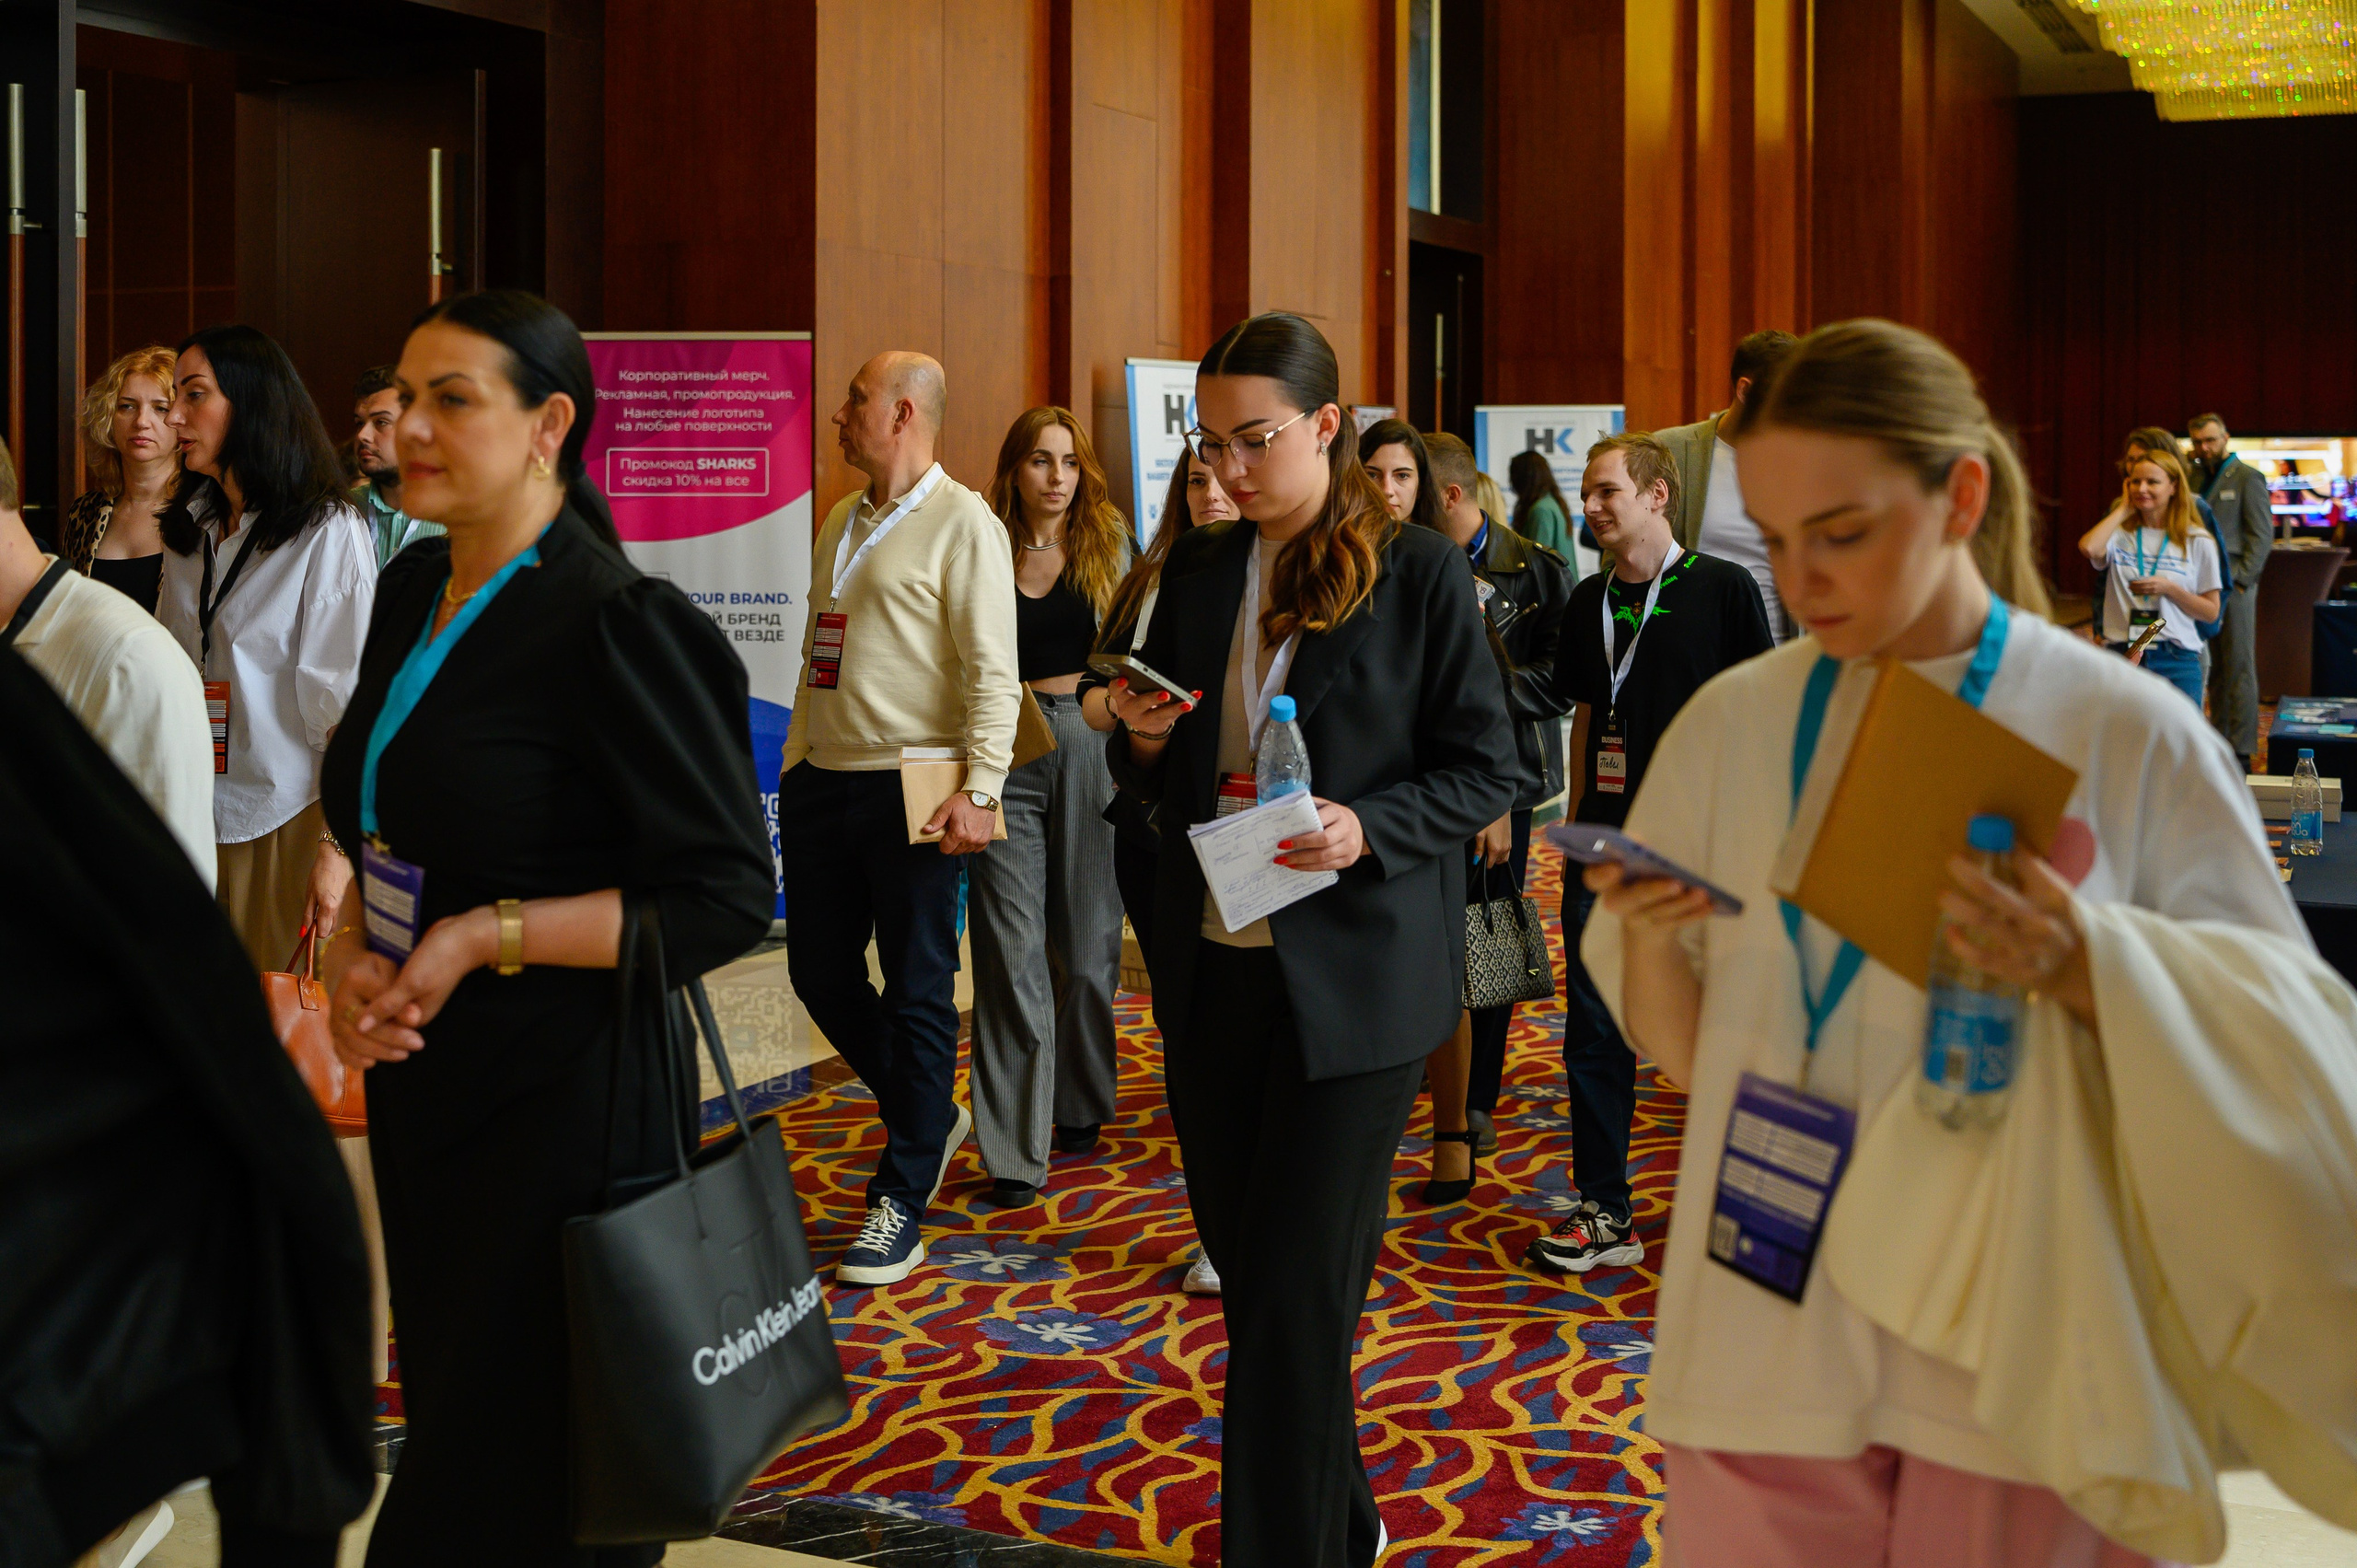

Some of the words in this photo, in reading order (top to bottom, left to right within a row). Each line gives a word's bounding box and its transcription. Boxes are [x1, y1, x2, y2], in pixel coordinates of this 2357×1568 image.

[618, 369, 728, 384] Корпоративный
[732, 371, 770, 384] мерч.
[595, 388, 670, 401] Рекламная,
[673, 389, 795, 402] промопродукция.
[623, 407, 699, 419] Нанесение
[702, 408, 764, 420] логотипа
[615, 423, 632, 432] на
[634, 420, 681, 432] любые
[684, 422, 772, 434] поверхности
[1526, 427, 1574, 454] HK
[620, 458, 694, 472] Промокод
[696, 458, 756, 470] SHARKS
[621, 476, 672, 487] скидка
[675, 473, 702, 486] 10%
[704, 477, 722, 486] на
[725, 477, 749, 486] все
[686, 592, 725, 605] OUR
[730, 592, 793, 605] BRAND.
[727, 613, 782, 626] БРЕНД
[734, 630, 784, 644] ВЕЗДЕ
